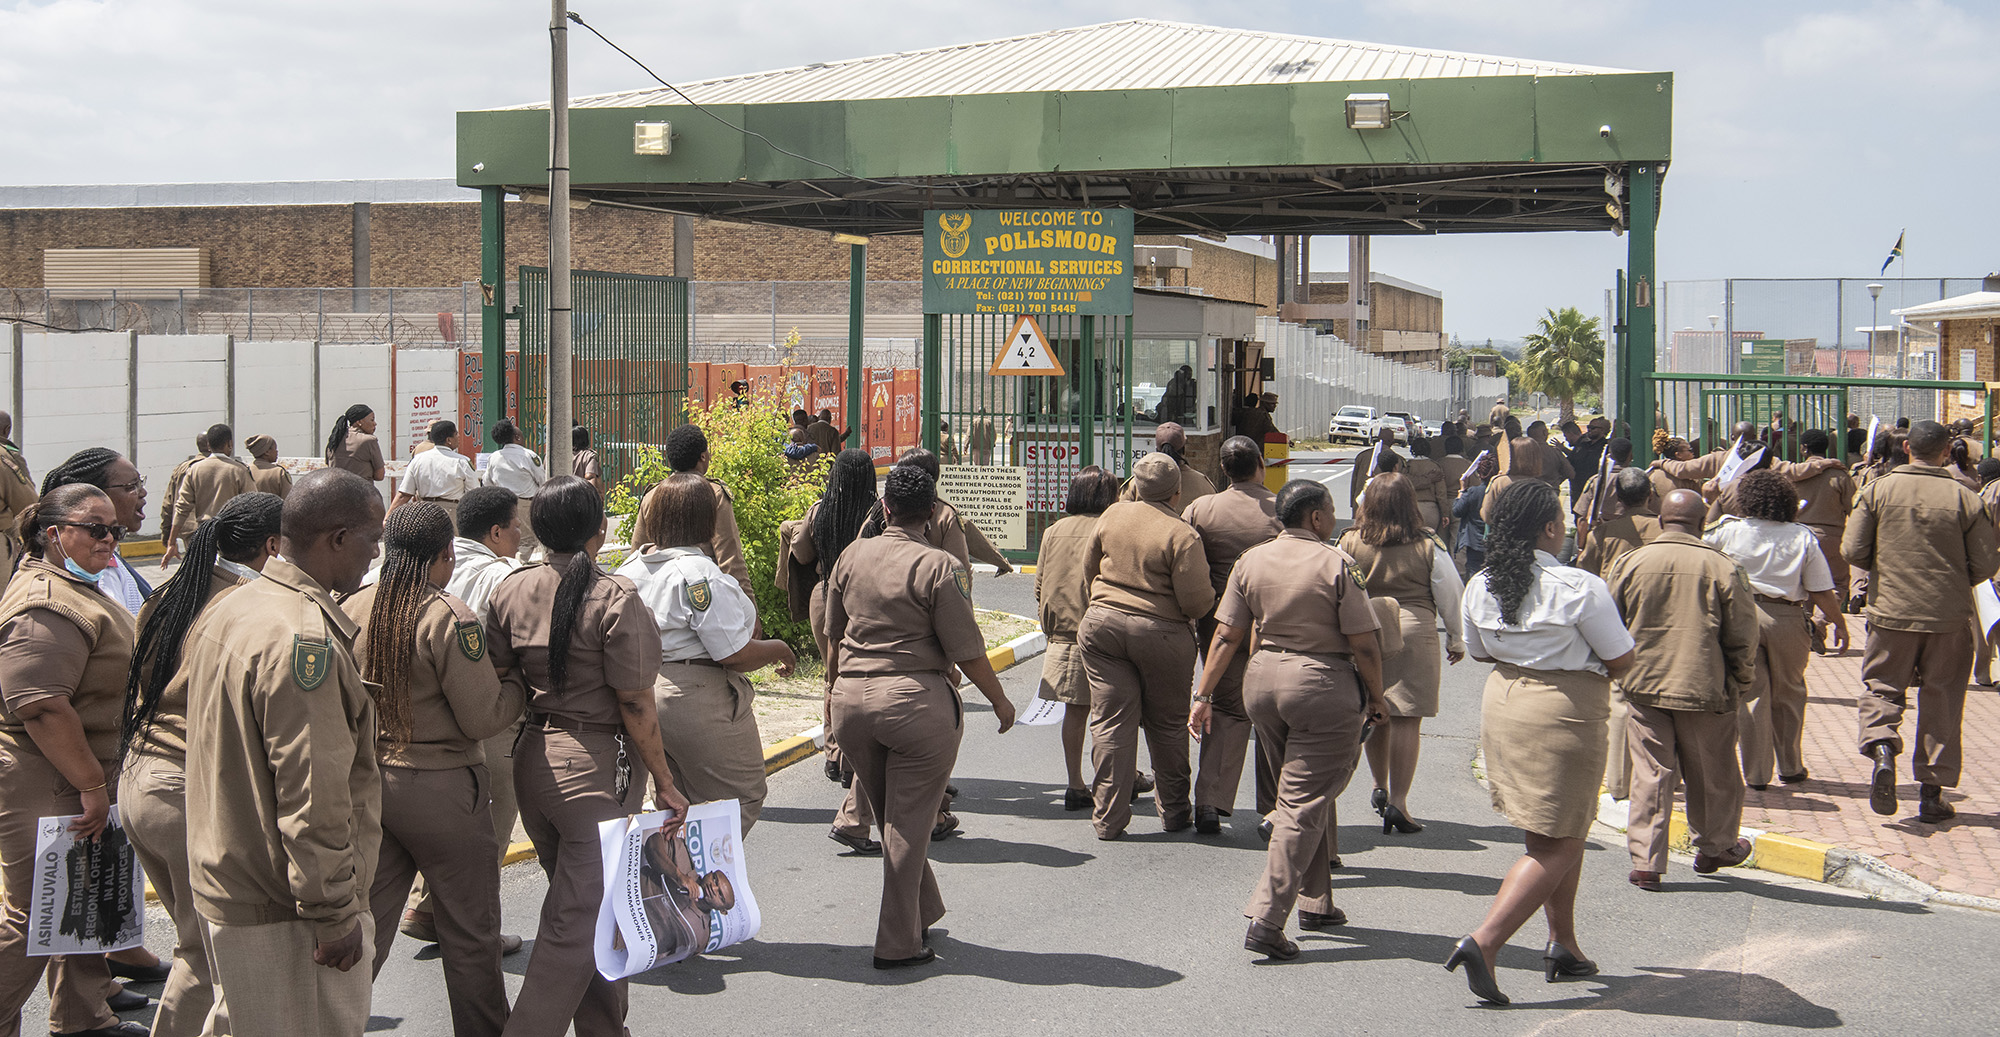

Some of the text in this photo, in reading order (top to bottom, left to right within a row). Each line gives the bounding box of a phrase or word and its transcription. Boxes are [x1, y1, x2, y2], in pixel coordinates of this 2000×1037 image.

[1000, 211, 1103, 226] WELCOME TO
[984, 229, 1117, 256] POLLSMOOR
[932, 260, 1123, 275] CORRECTIONAL SERVICES
[956, 277, 990, 290] PLACE
[992, 277, 1008, 290] OF
[1008, 277, 1036, 290] NEW
[1036, 277, 1110, 290] BEGINNINGS"
[976, 291, 1078, 301] Tel: (021) 700 1111/
[976, 304, 1076, 313] Fax: (021) 701 5445
[413, 395, 438, 409] STOP
[1027, 446, 1079, 460] STOP
[71, 855, 87, 916] ESTABLISH
[104, 863, 115, 901] IN ALL
[117, 844, 129, 912] PROVINCES
[38, 851, 58, 947] ASINAL'UVALO
[85, 879, 100, 937] REGIONAL
[626, 879, 645, 941] COMMSSIONER
[634, 869, 639, 879] OF
[637, 908, 652, 942] LABOUR,
